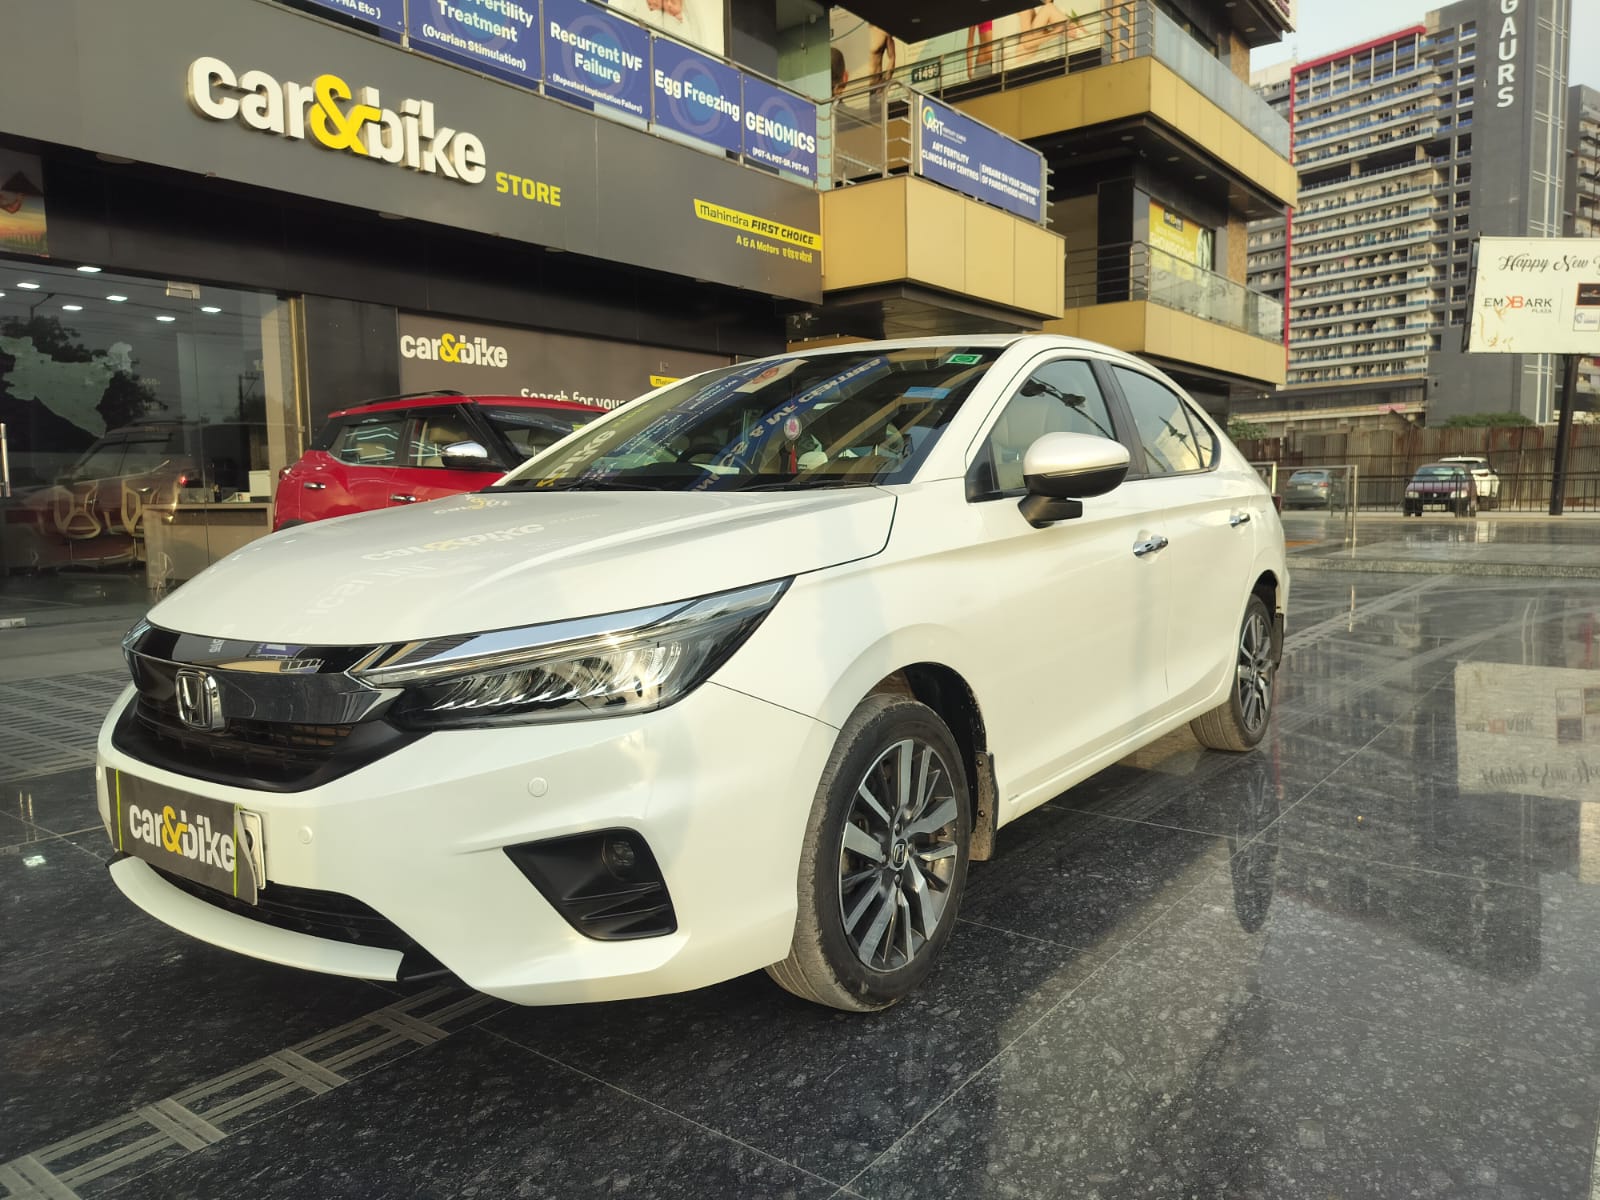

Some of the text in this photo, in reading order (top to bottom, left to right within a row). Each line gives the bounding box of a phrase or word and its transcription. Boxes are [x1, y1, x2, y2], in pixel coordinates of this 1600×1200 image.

[358, 2, 375, 16] Etc
[438, 0, 518, 42] Treatment
[422, 24, 527, 71] (Ovarian Stimulation)
[550, 21, 643, 72] Recurrent IVF
[574, 52, 621, 84] Failure
[1497, 0, 1518, 108] GAURS
[654, 68, 740, 122] Egg Freezing
[187, 56, 562, 207] car&bike STORE
[745, 110, 816, 154] GENOMICS
[699, 204, 814, 246] Mahindra FIRST CHOICE
[757, 241, 780, 256] Motors
[1498, 253, 1549, 272] Happy
[1552, 255, 1588, 272] New
[400, 332, 508, 368] car&bike
[129, 804, 236, 872] car&bike
